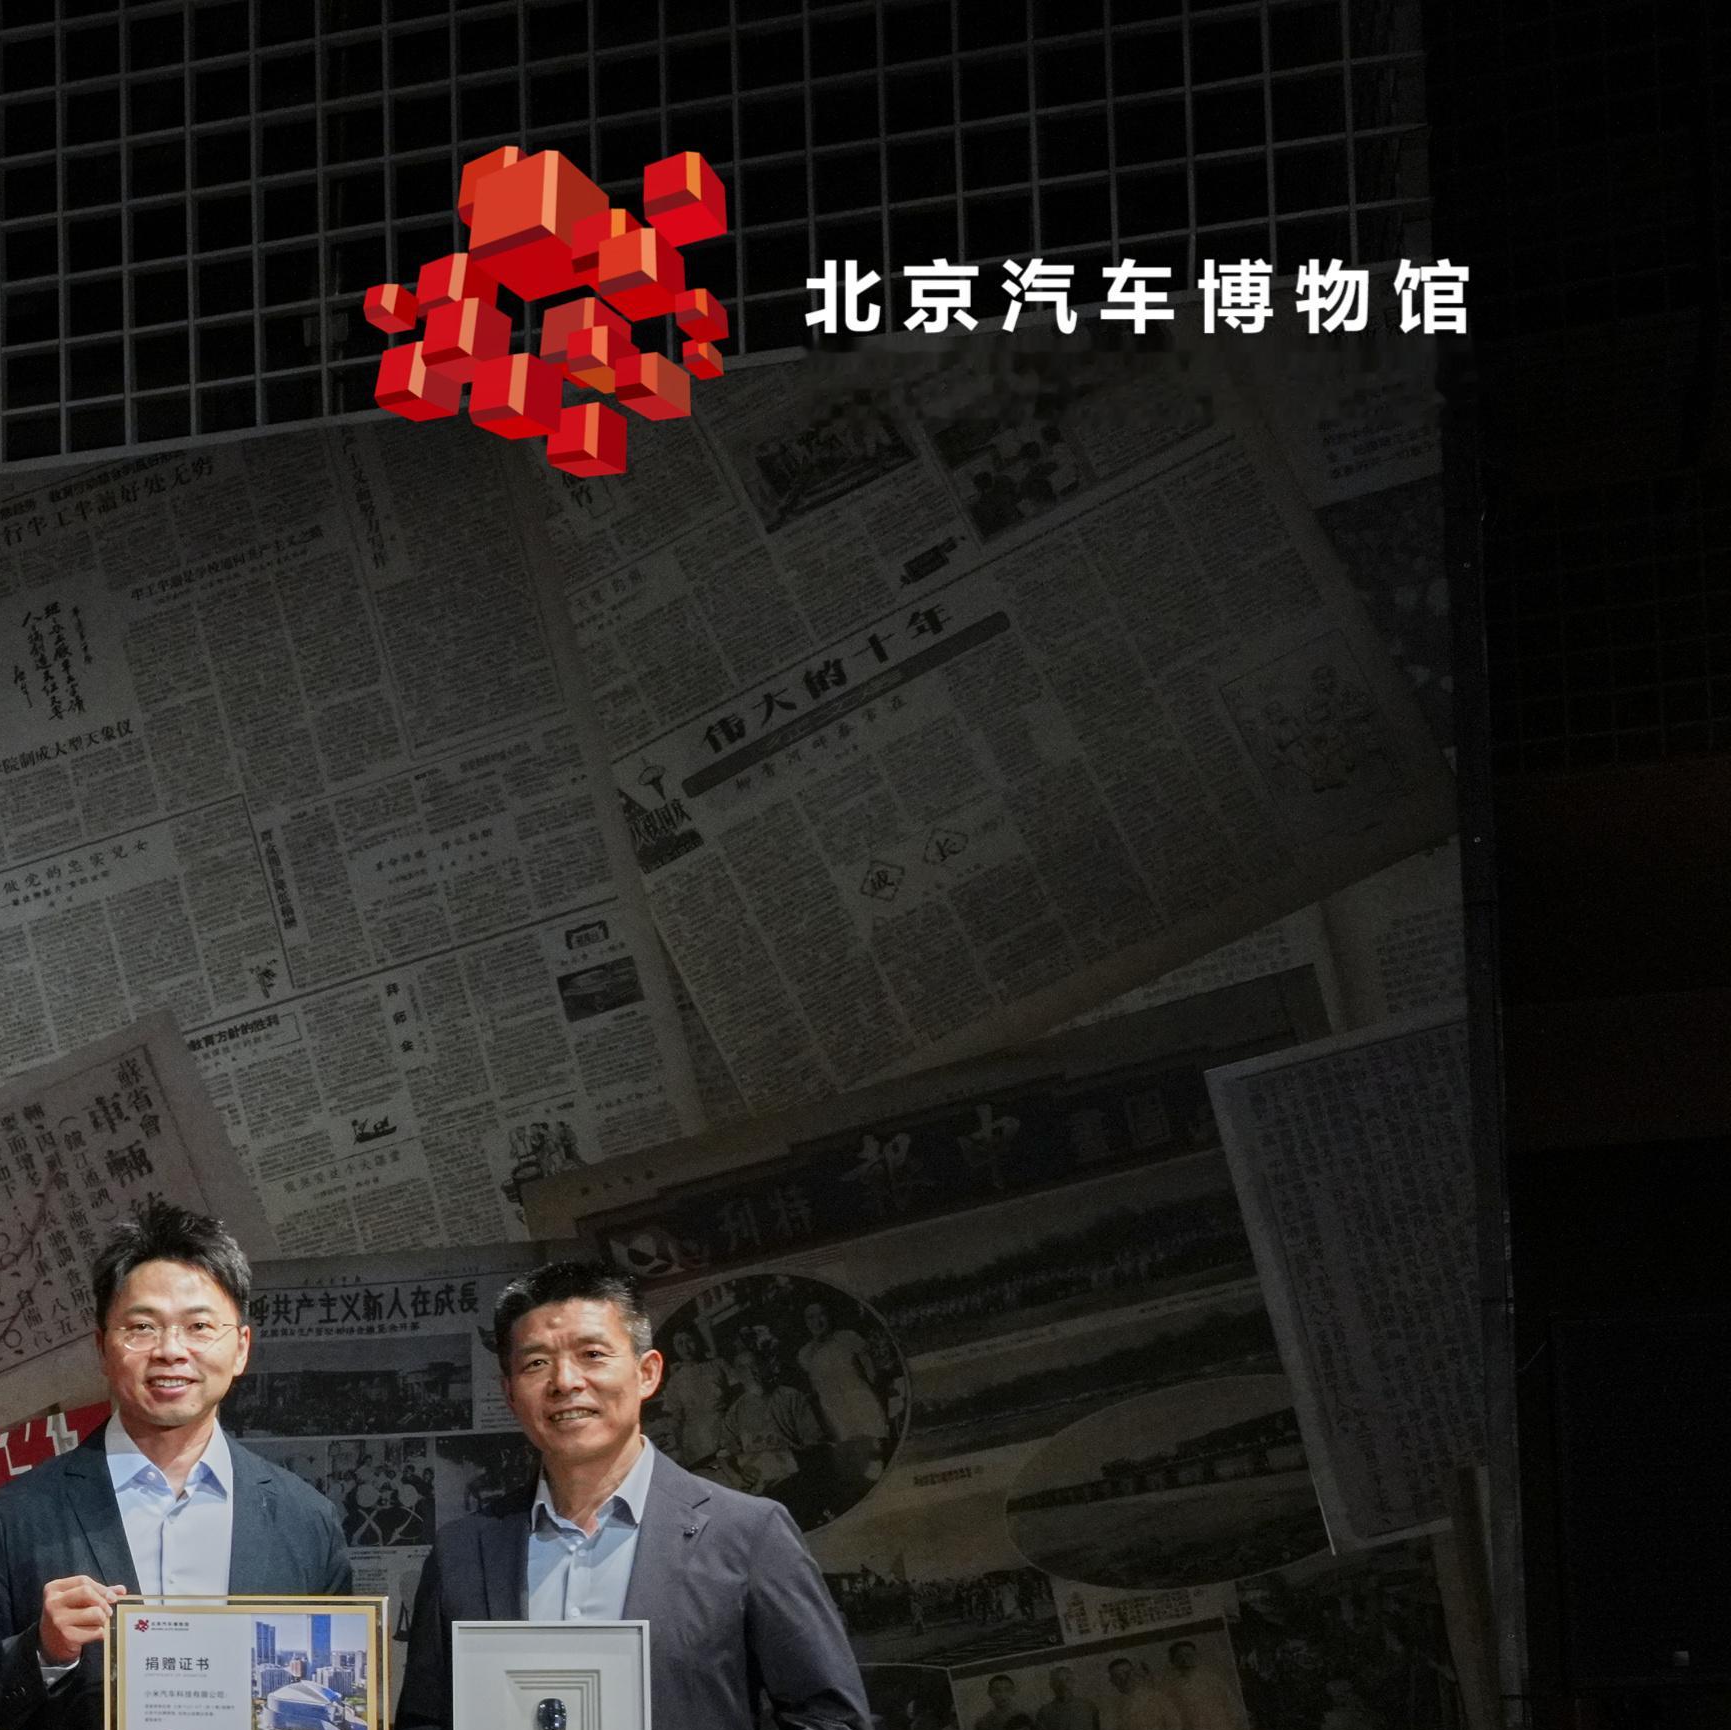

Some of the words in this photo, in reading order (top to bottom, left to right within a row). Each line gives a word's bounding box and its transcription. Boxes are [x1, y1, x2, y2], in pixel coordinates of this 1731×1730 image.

[701, 608, 952, 755] 伟大的十年
[144, 1656, 211, 1672] 捐赠证书
